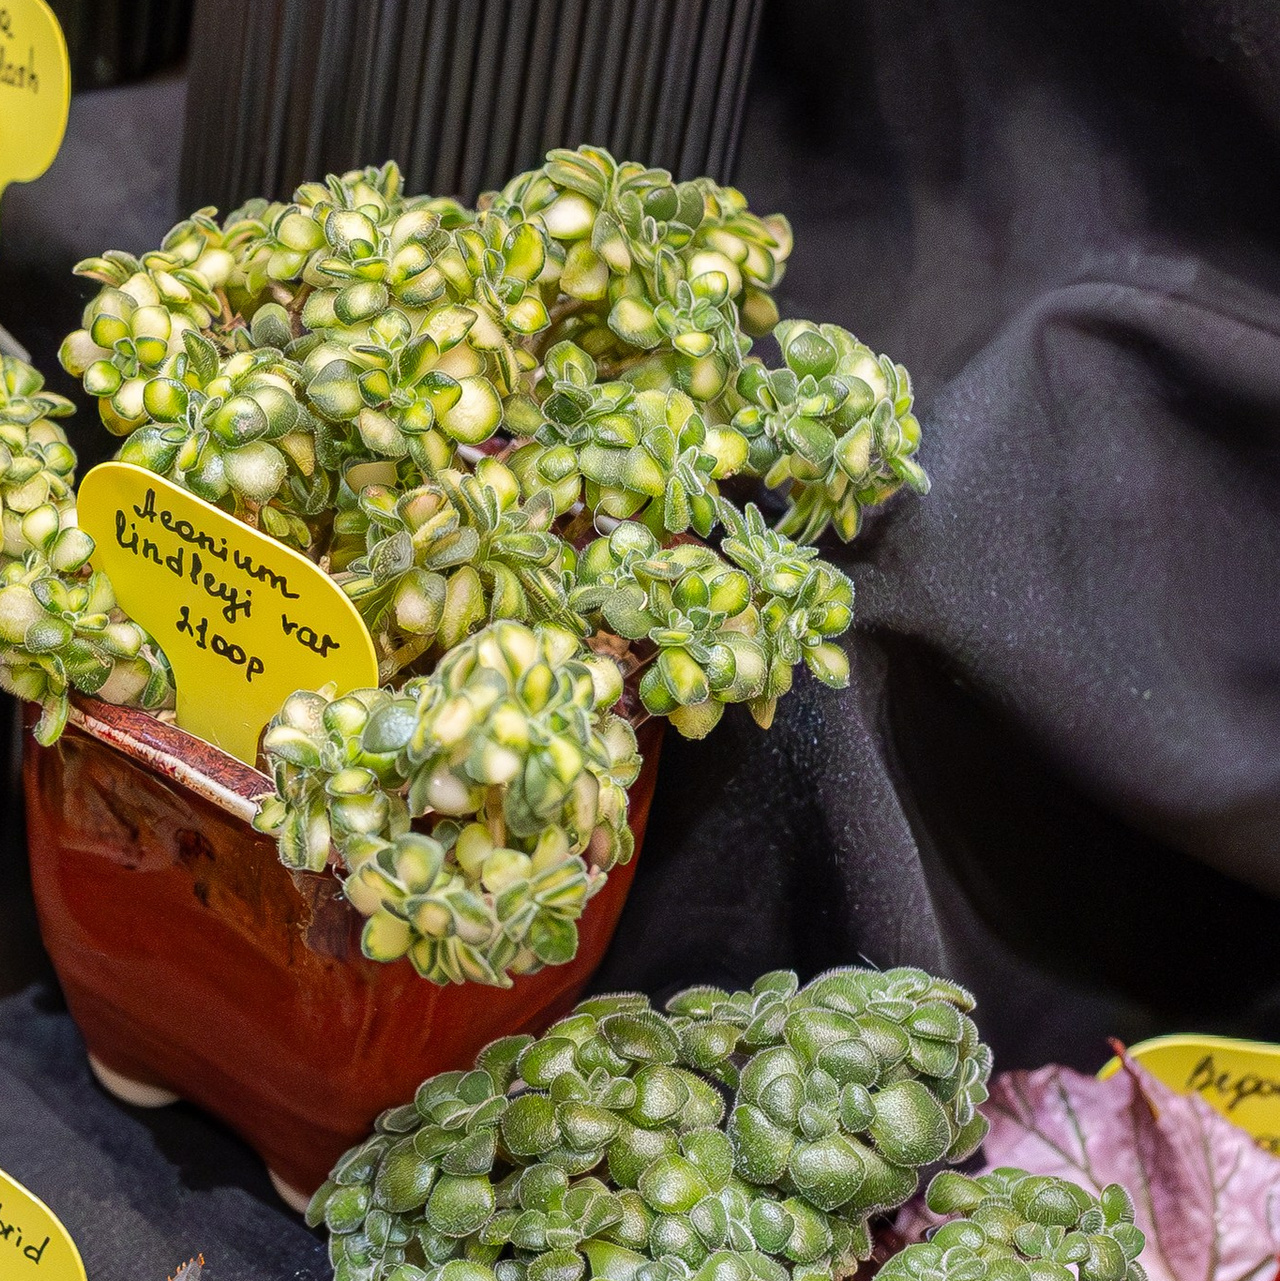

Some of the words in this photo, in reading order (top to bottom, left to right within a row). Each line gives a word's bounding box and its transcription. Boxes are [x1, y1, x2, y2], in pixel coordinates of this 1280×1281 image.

[115, 509, 252, 624] lindleyi
[281, 613, 341, 658] var
[133, 488, 300, 600] Aeonium
